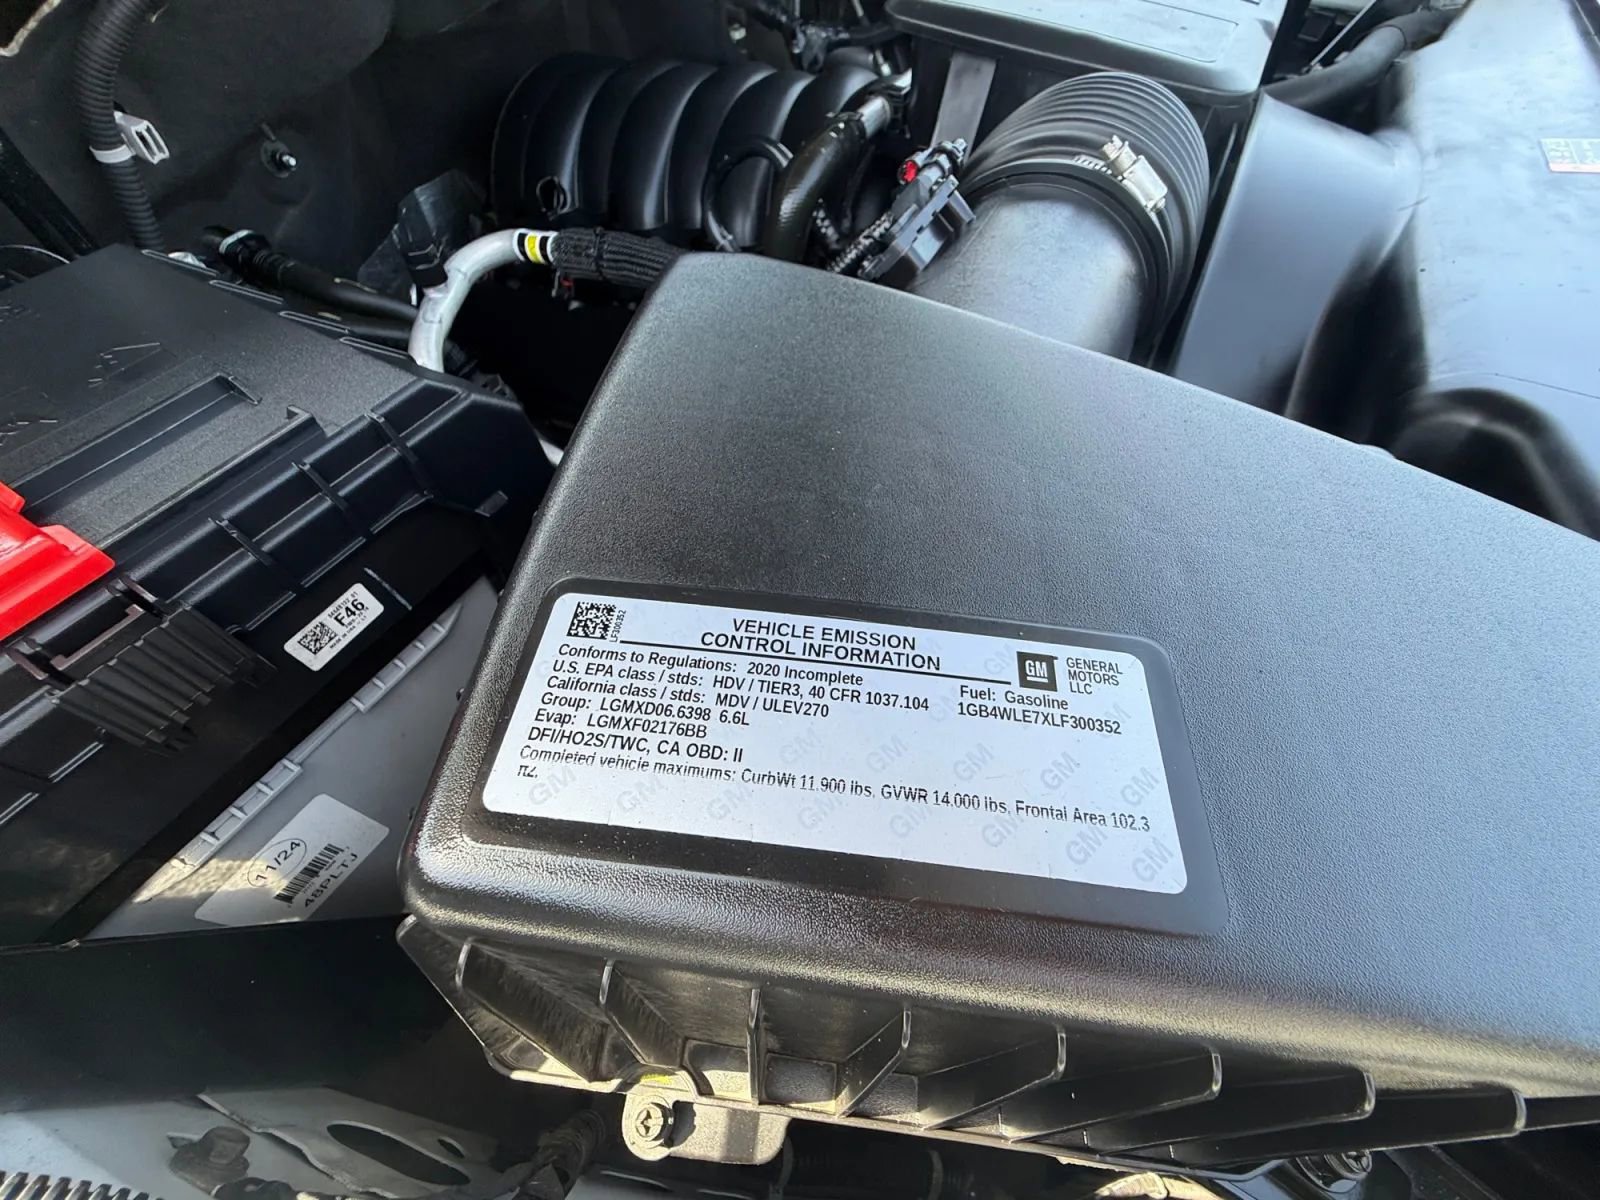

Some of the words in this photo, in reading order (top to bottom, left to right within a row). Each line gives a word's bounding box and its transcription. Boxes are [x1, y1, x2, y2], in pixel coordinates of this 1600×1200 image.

[333, 599, 365, 626] F46
[733, 618, 815, 640] VEHICLE
[821, 627, 916, 650] EMISSION
[559, 643, 627, 661] Conforms
[630, 651, 644, 663] to
[648, 652, 737, 673] Regulations:
[747, 662, 780, 677] 2020
[785, 666, 863, 686] Incomplete
[701, 632, 796, 655] CONTROL
[802, 642, 940, 671] INFORMATION
[1066, 657, 1123, 675] GENERAL
[552, 660, 580, 674] U.S.
[585, 663, 613, 677] EPA
[618, 667, 655, 681] class
[658, 670, 666, 682] /
[667, 671, 703, 686] stds:
[713, 675, 746, 692] HDV
[748, 678, 755, 692] /
[758, 680, 803, 698] TIER3,
[808, 685, 825, 699] 40
[830, 688, 861, 703] CFR
[865, 691, 929, 711] 1037.104
[1068, 669, 1120, 687] MOTORS
[1070, 682, 1093, 695] LLC
[541, 692, 592, 710] Group:
[600, 697, 711, 721] LGMXD06.6398
[719, 710, 750, 726] 6.6L
[547, 675, 615, 695] California
[620, 683, 657, 698] class
[660, 686, 667, 699] /
[669, 688, 706, 704] stds:
[715, 693, 750, 709] MDV
[752, 697, 759, 710] /
[762, 698, 829, 718] ULEV270
[960, 685, 996, 702] Fuel:
[1004, 690, 1069, 710] Gasoline
[535, 708, 576, 727] Evap:
[587, 714, 707, 738] LGMXF02176BB
[957, 702, 1122, 735] 1GB4WLE7XLF300352
[657, 740, 680, 756] CA
[686, 743, 728, 761] OBD:
[520, 745, 597, 766] Completed
[600, 754, 649, 772] vehicle
[654, 761, 736, 781] maximums:
[741, 768, 797, 788] CurbWt
[881, 784, 928, 804] GVWR
[1016, 800, 1068, 822] Frontal
[1073, 807, 1107, 827] Area
[1111, 812, 1150, 832] 102.3
